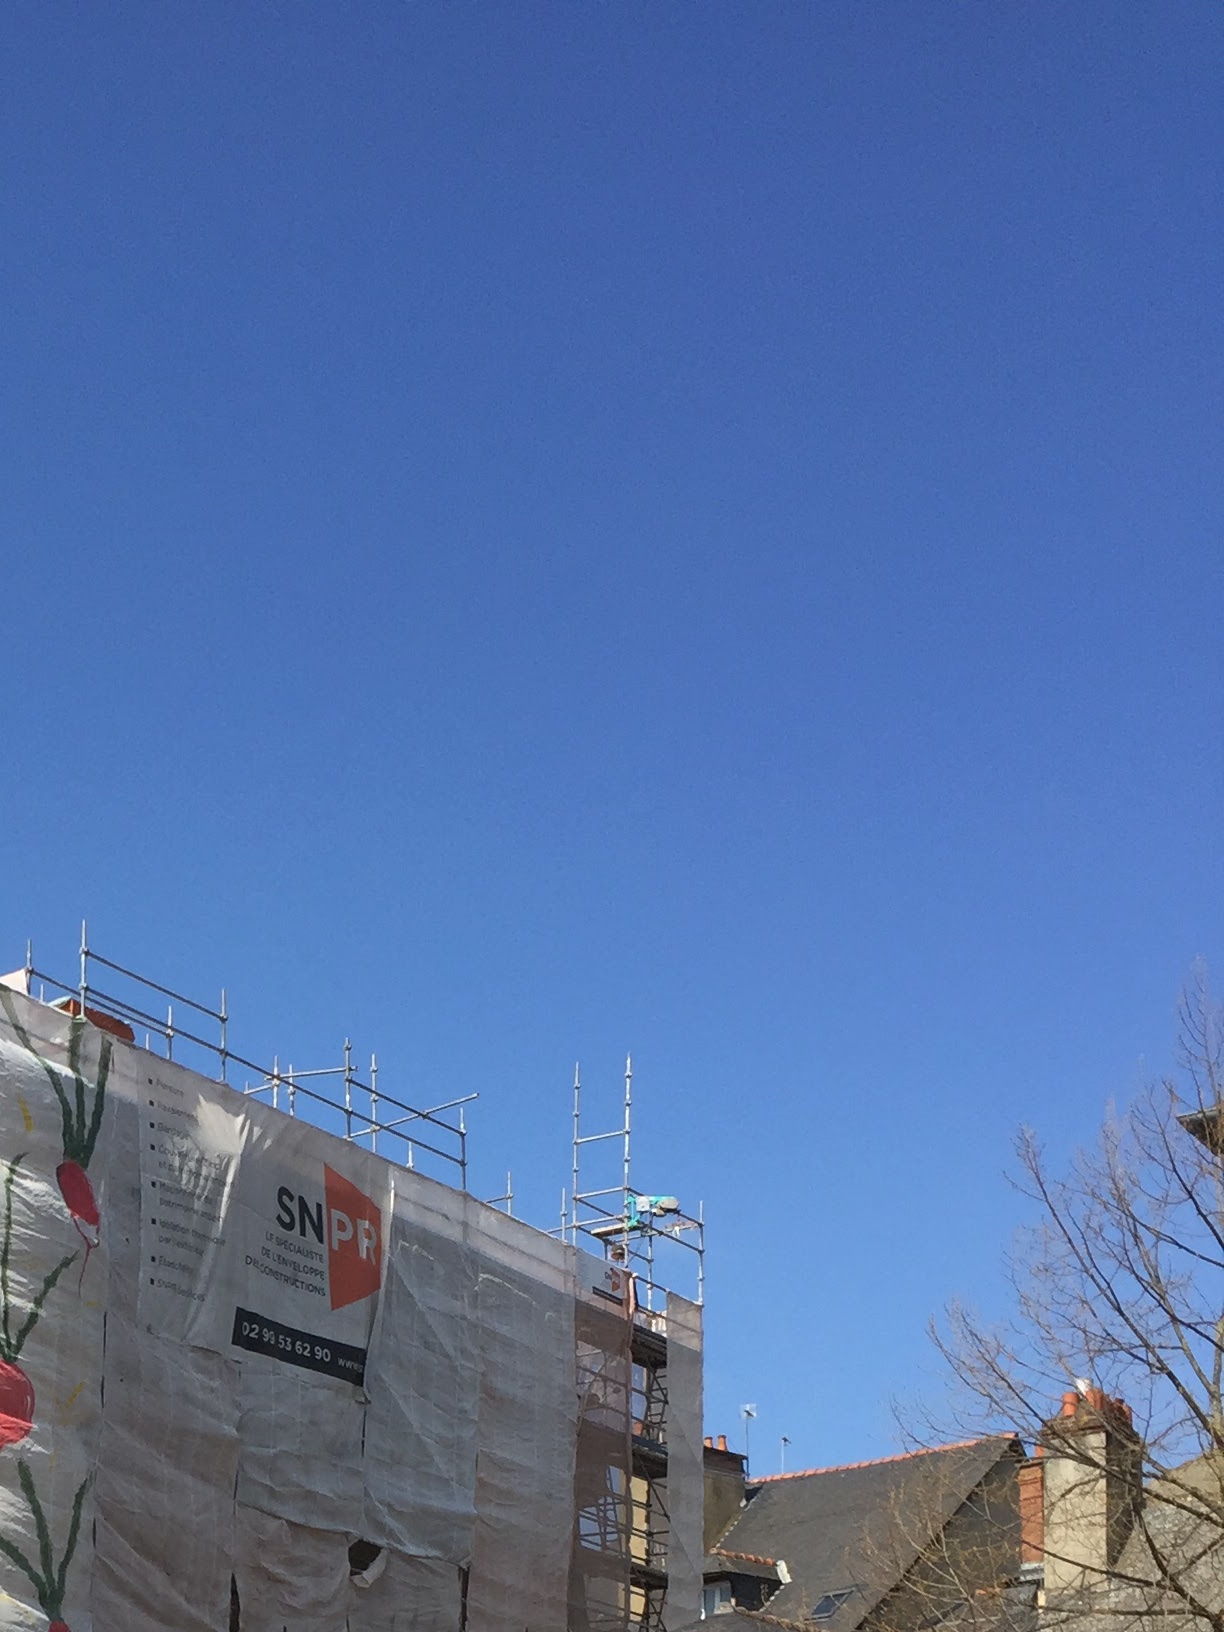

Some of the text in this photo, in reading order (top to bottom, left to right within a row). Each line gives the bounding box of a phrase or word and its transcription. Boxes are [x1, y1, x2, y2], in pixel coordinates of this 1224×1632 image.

[276, 1185, 378, 1266] SNPR
[242, 1321, 259, 1339] 02
[262, 1327, 275, 1345] 99
[277, 1334, 292, 1351] 53
[295, 1340, 311, 1357] 62
[314, 1345, 331, 1362] 90
